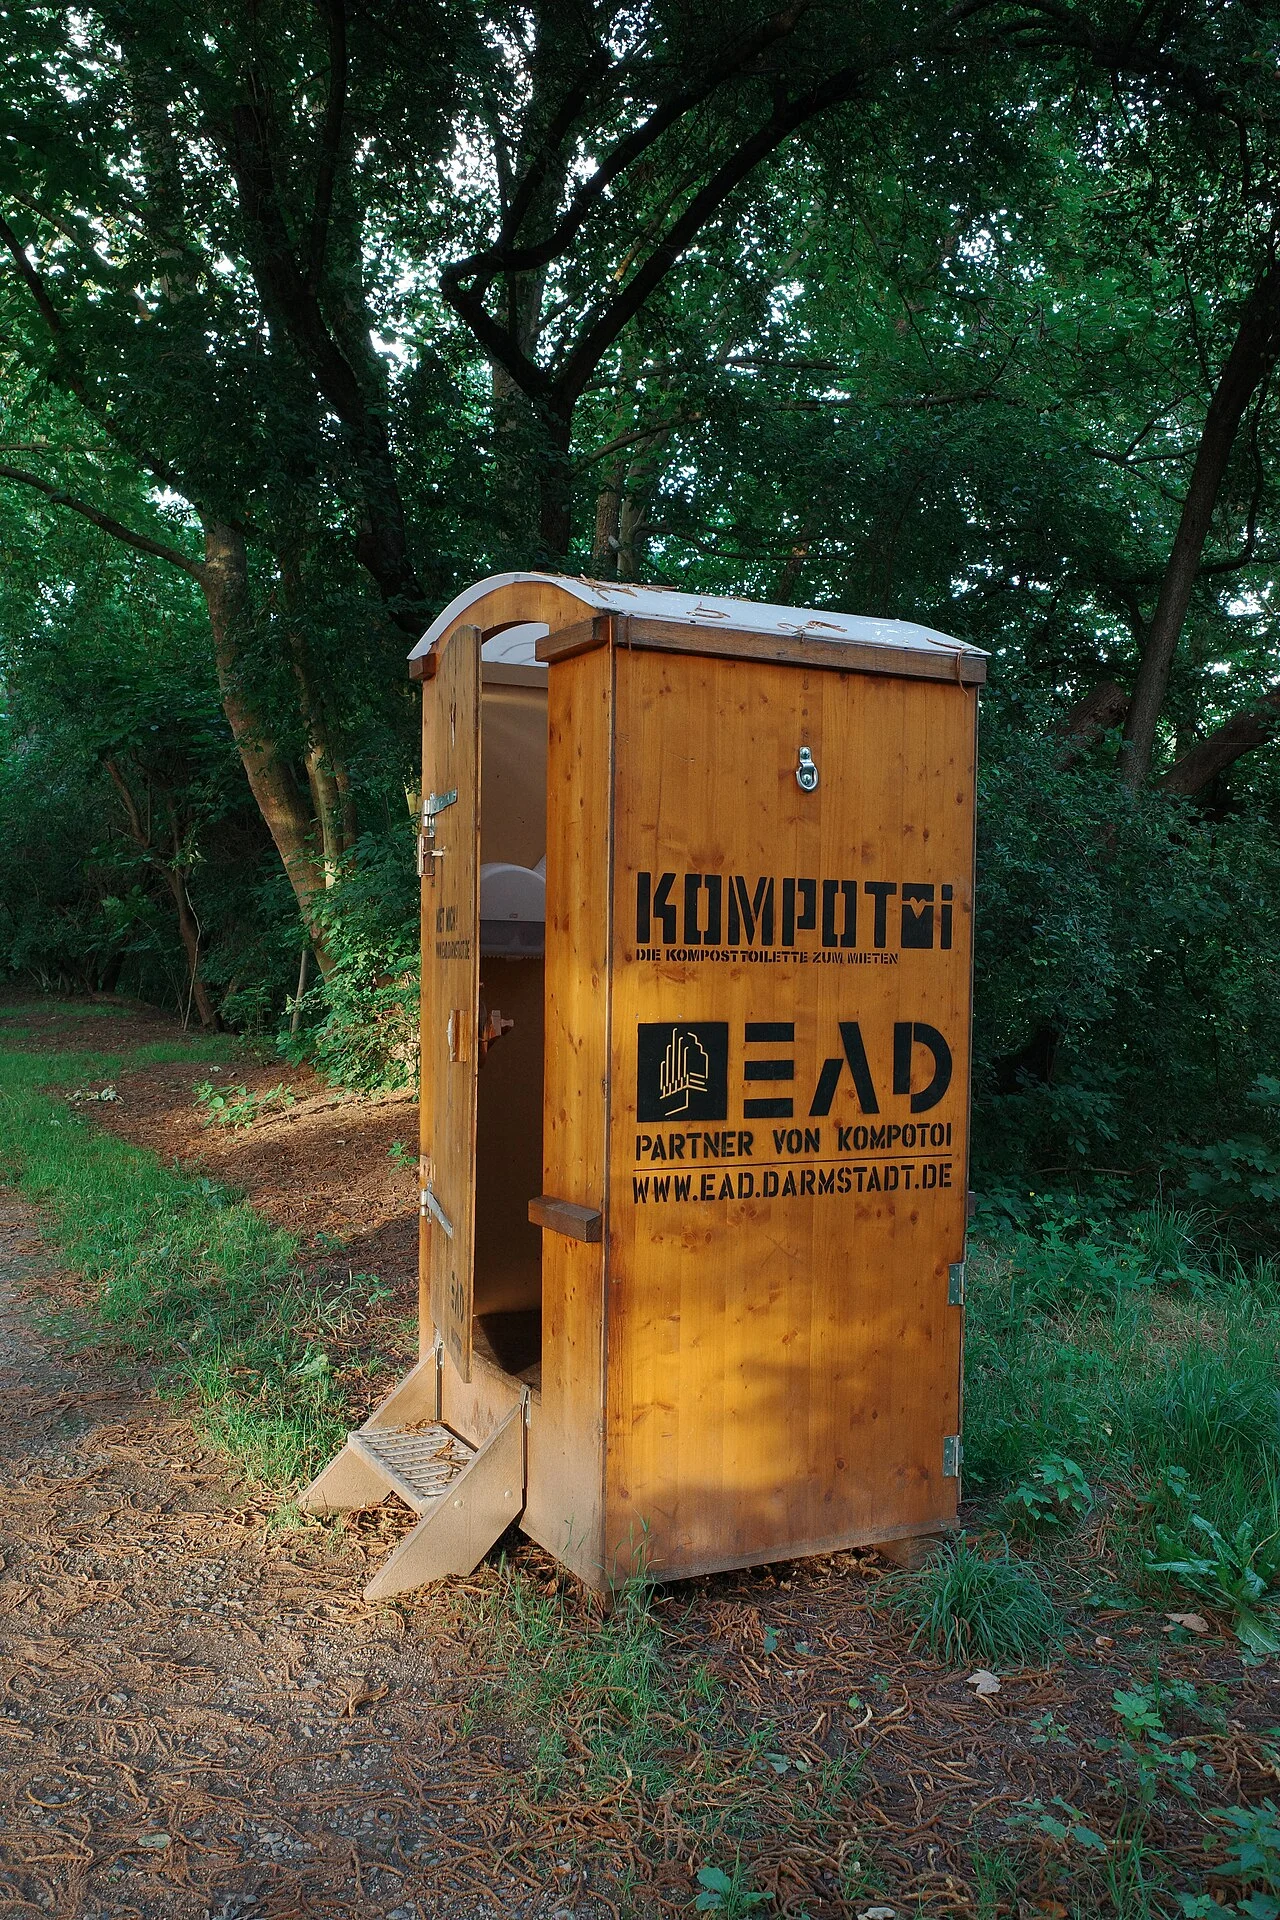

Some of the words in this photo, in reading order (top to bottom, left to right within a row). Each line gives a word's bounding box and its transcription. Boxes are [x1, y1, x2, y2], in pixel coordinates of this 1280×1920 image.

[636, 949, 661, 961] DIE
[666, 949, 808, 963] KOMPOSTTOILETTE
[813, 952, 843, 964] ZUM
[848, 953, 898, 965] MIETEN
[744, 1022, 952, 1119] EAD
[636, 1131, 753, 1161] PARTNER
[773, 1128, 820, 1155] VON
[838, 1122, 952, 1151] KOMPOTOI
[632, 1163, 952, 1204] WWW.EAD.DARMSTADT.DE
